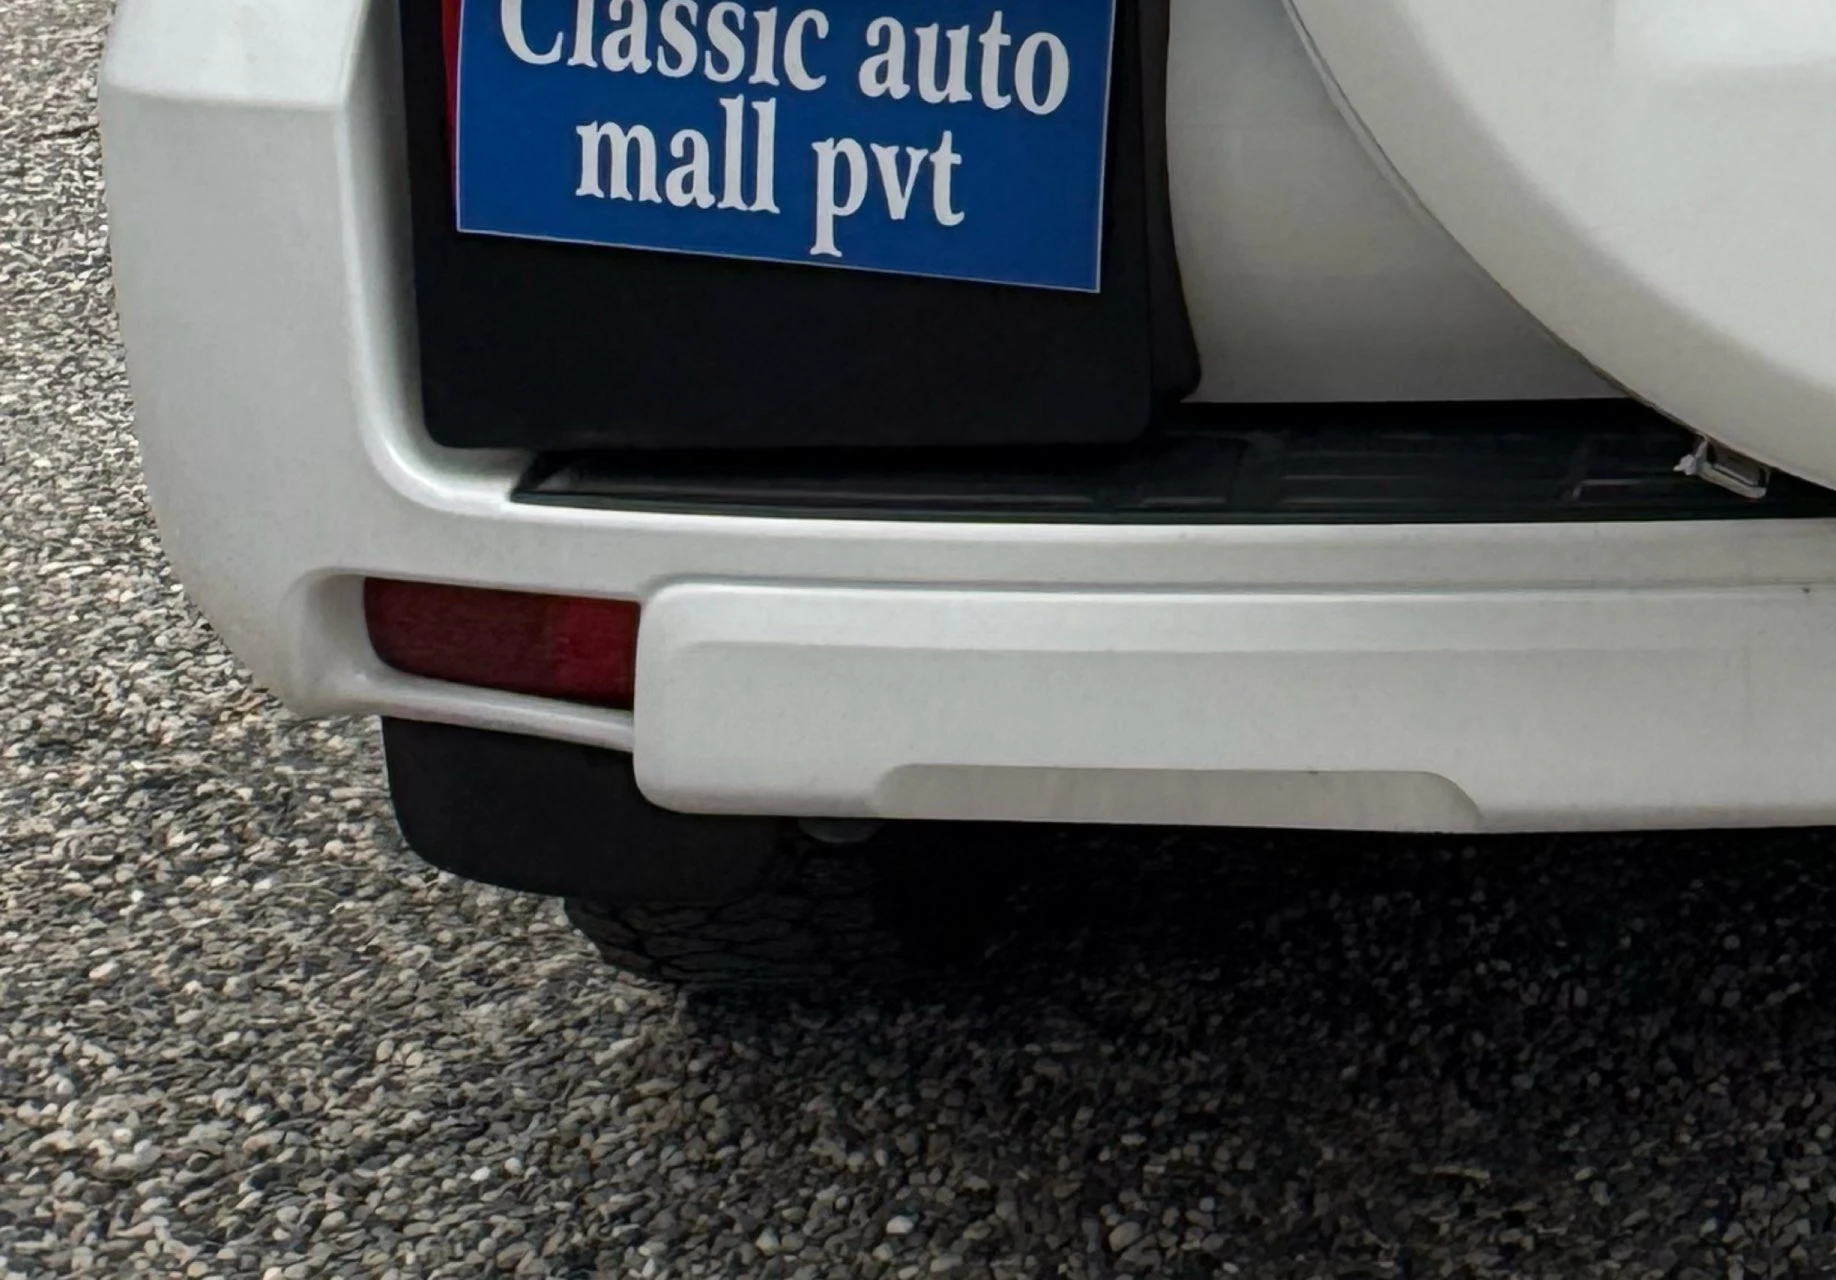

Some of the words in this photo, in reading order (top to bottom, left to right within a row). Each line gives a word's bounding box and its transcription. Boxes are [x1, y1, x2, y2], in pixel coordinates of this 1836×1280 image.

[858, 10, 1071, 116] auto
[575, 94, 780, 214] mall
[810, 130, 966, 258] pvt
